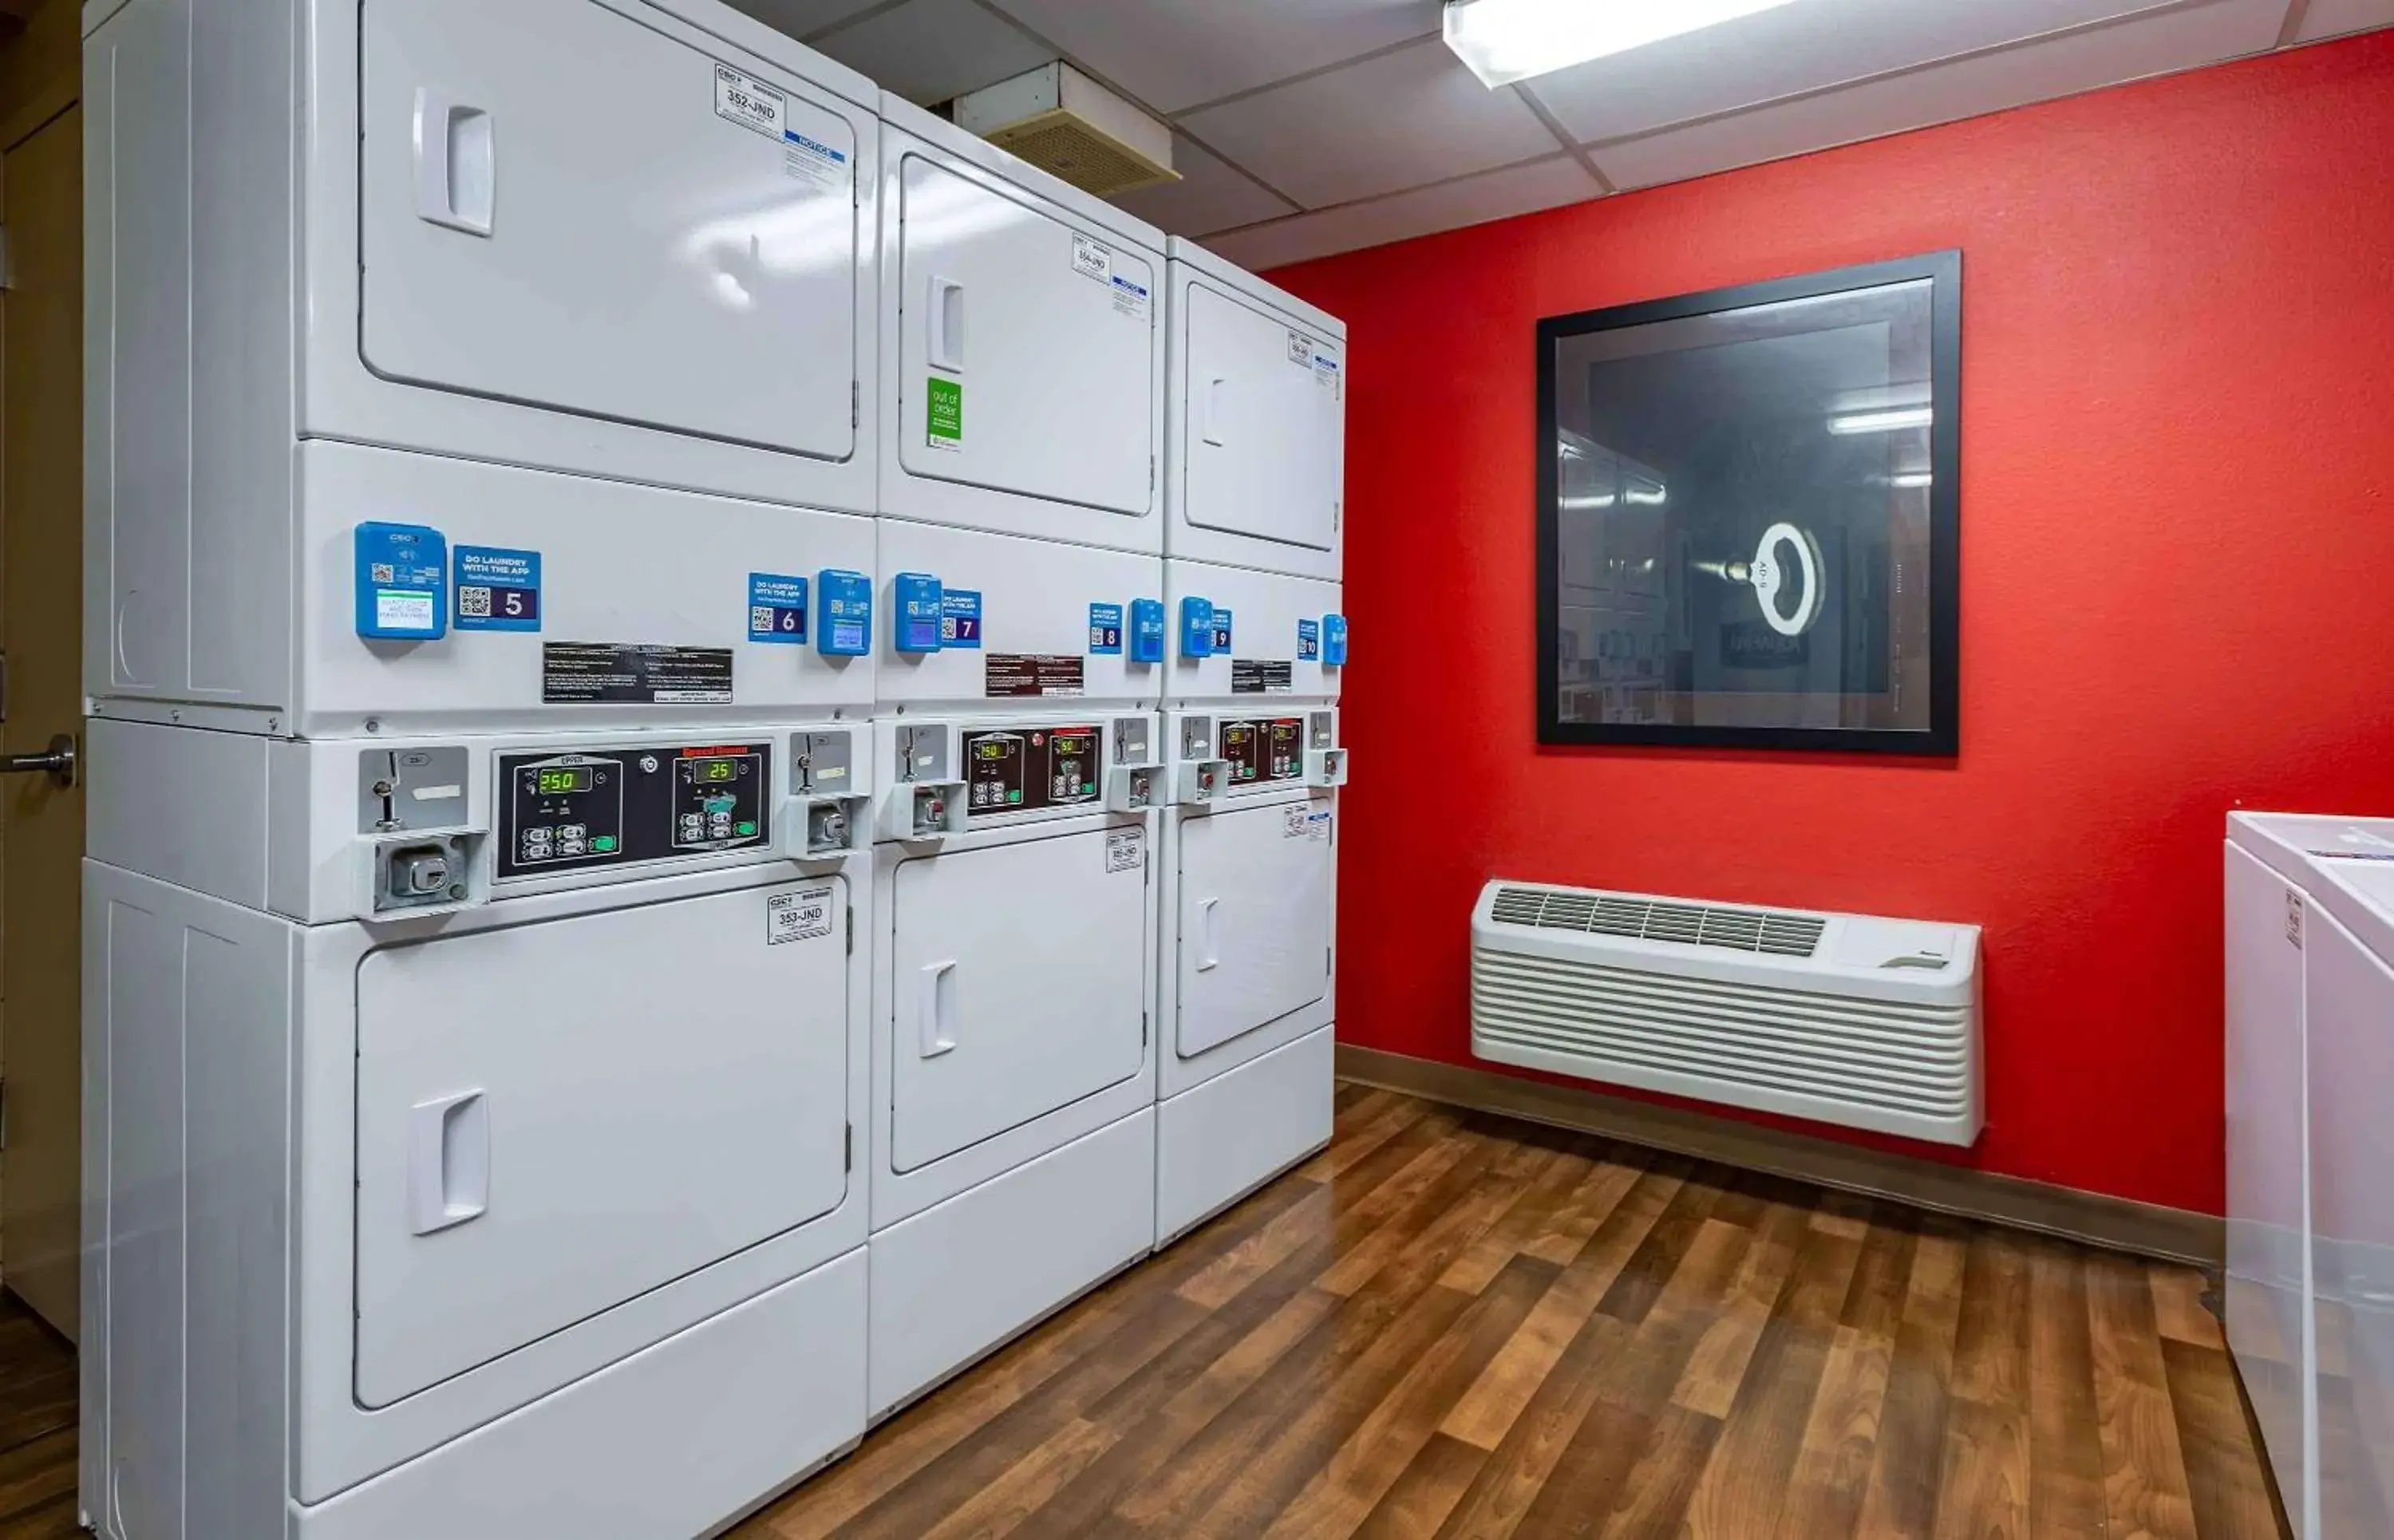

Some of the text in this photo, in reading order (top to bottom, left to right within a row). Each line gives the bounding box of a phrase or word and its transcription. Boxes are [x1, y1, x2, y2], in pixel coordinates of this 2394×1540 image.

[728, 89, 776, 119] 352-JND
[465, 555, 527, 567] DO LAUNDRY
[463, 563, 489, 573] WITH
[491, 566, 510, 575] THE
[505, 593, 523, 615] 5
[783, 612, 794, 630] 6
[963, 622, 973, 637] 7
[1108, 630, 1115, 645] 8
[1219, 633, 1227, 645] 9
[1306, 641, 1316, 653] 10
[710, 764, 729, 778] 25
[780, 908, 823, 925] 353-JND
